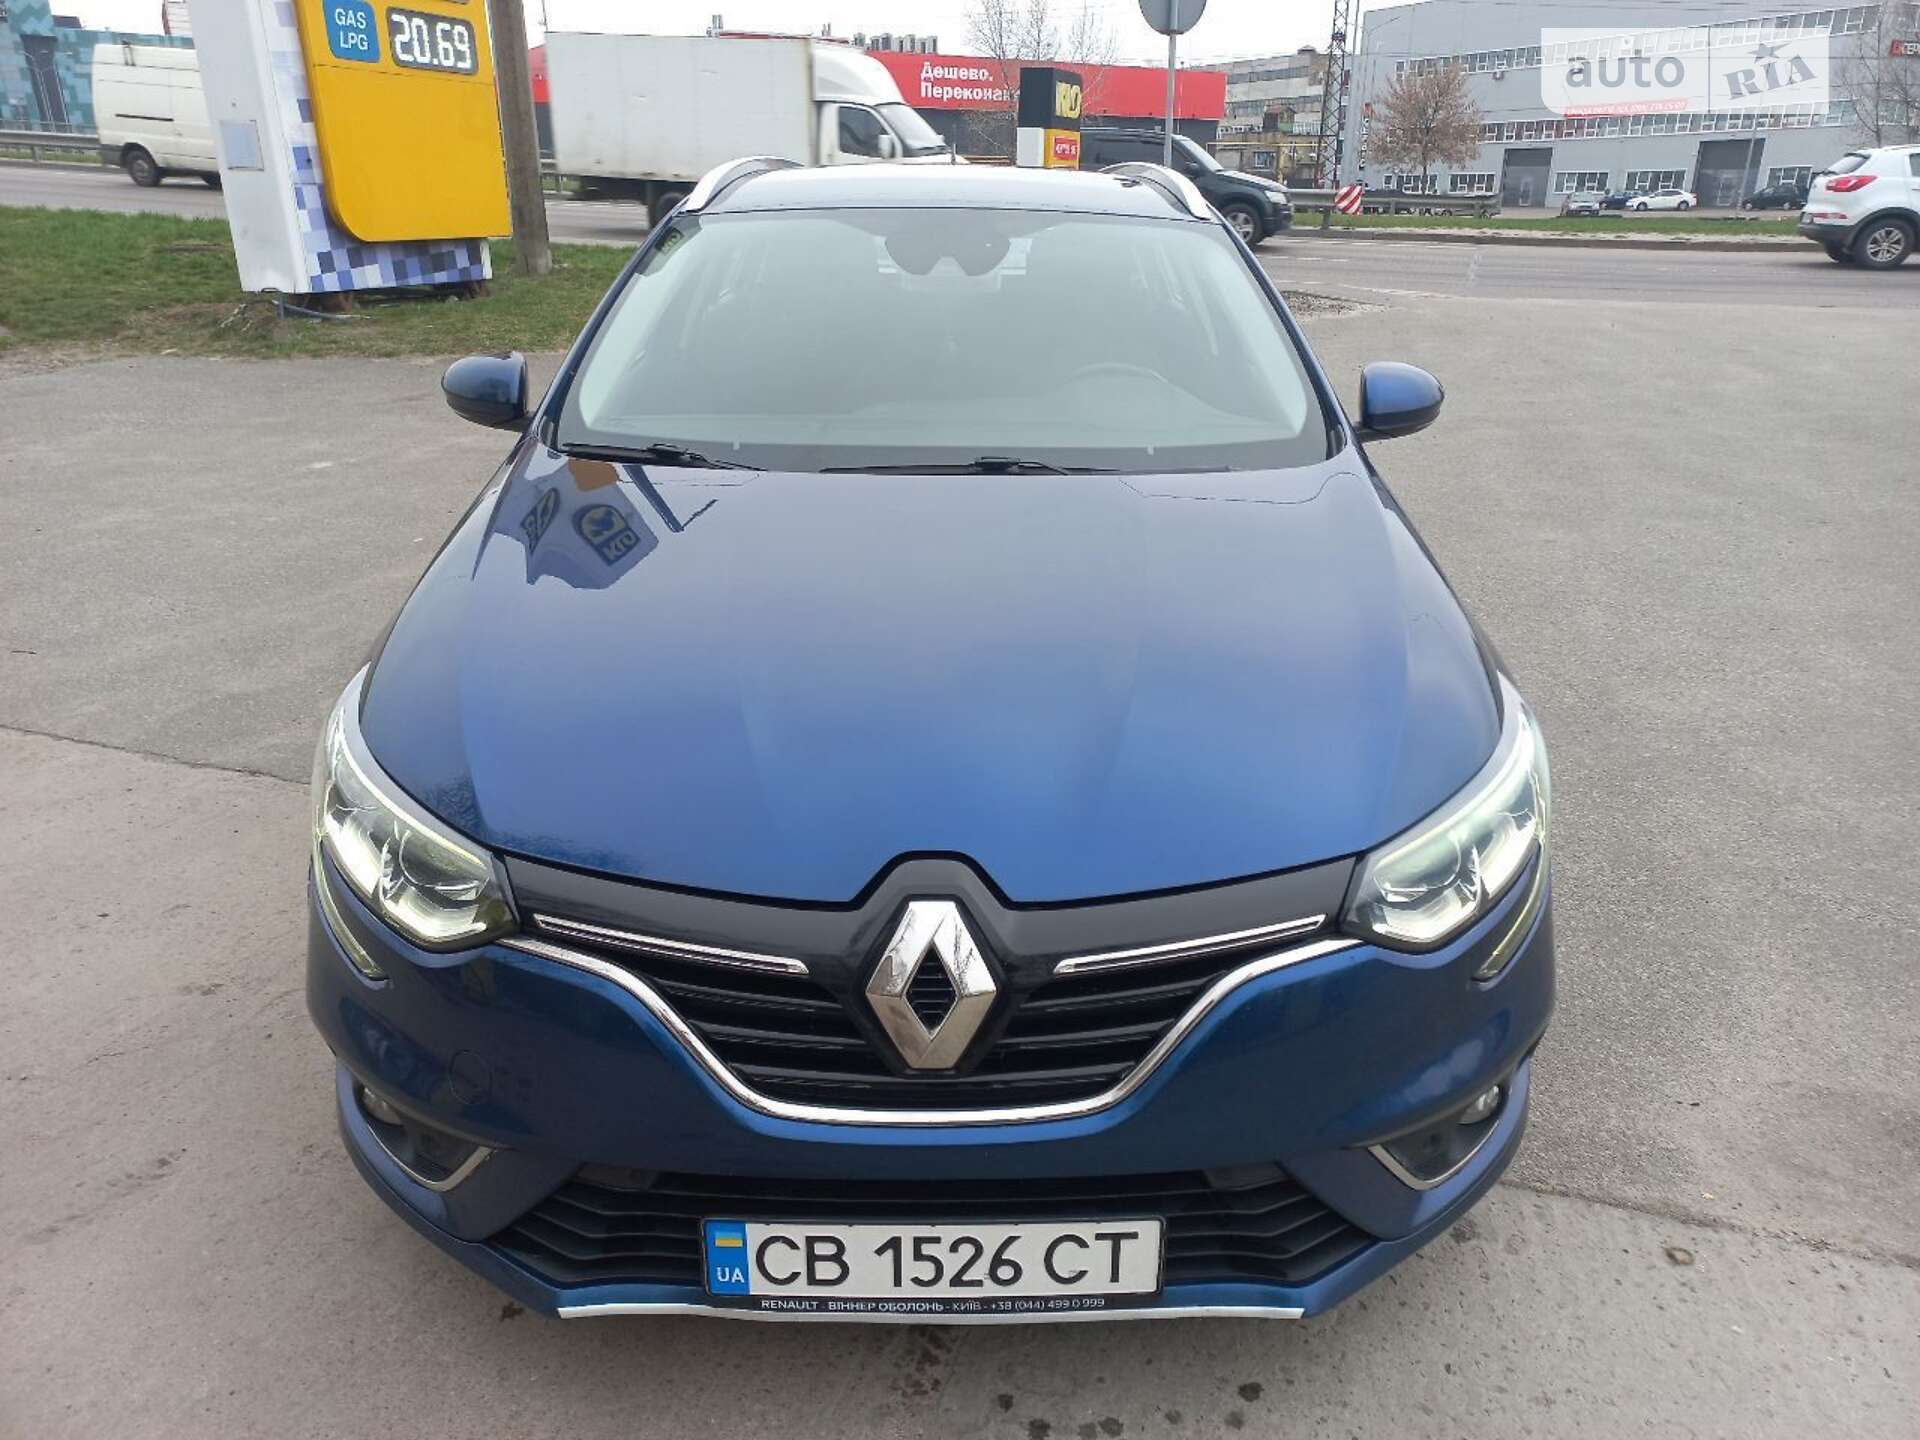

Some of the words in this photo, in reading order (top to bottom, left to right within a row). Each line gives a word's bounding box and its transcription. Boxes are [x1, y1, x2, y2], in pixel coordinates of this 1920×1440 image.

[335, 8, 368, 28] GAS
[339, 31, 369, 51] LPG
[391, 14, 472, 70] 20.69
[921, 61, 994, 82] Дешево.
[756, 1235, 850, 1286] CB
[873, 1235, 1024, 1288] 1526
[1043, 1231, 1139, 1285] CT
[716, 1266, 745, 1284] UA
[761, 1299, 819, 1311] RENAULT
[878, 1301, 944, 1313] ОБОЛОНЬ
[1014, 1299, 1045, 1311] (044)
[1083, 1297, 1106, 1309] 999
